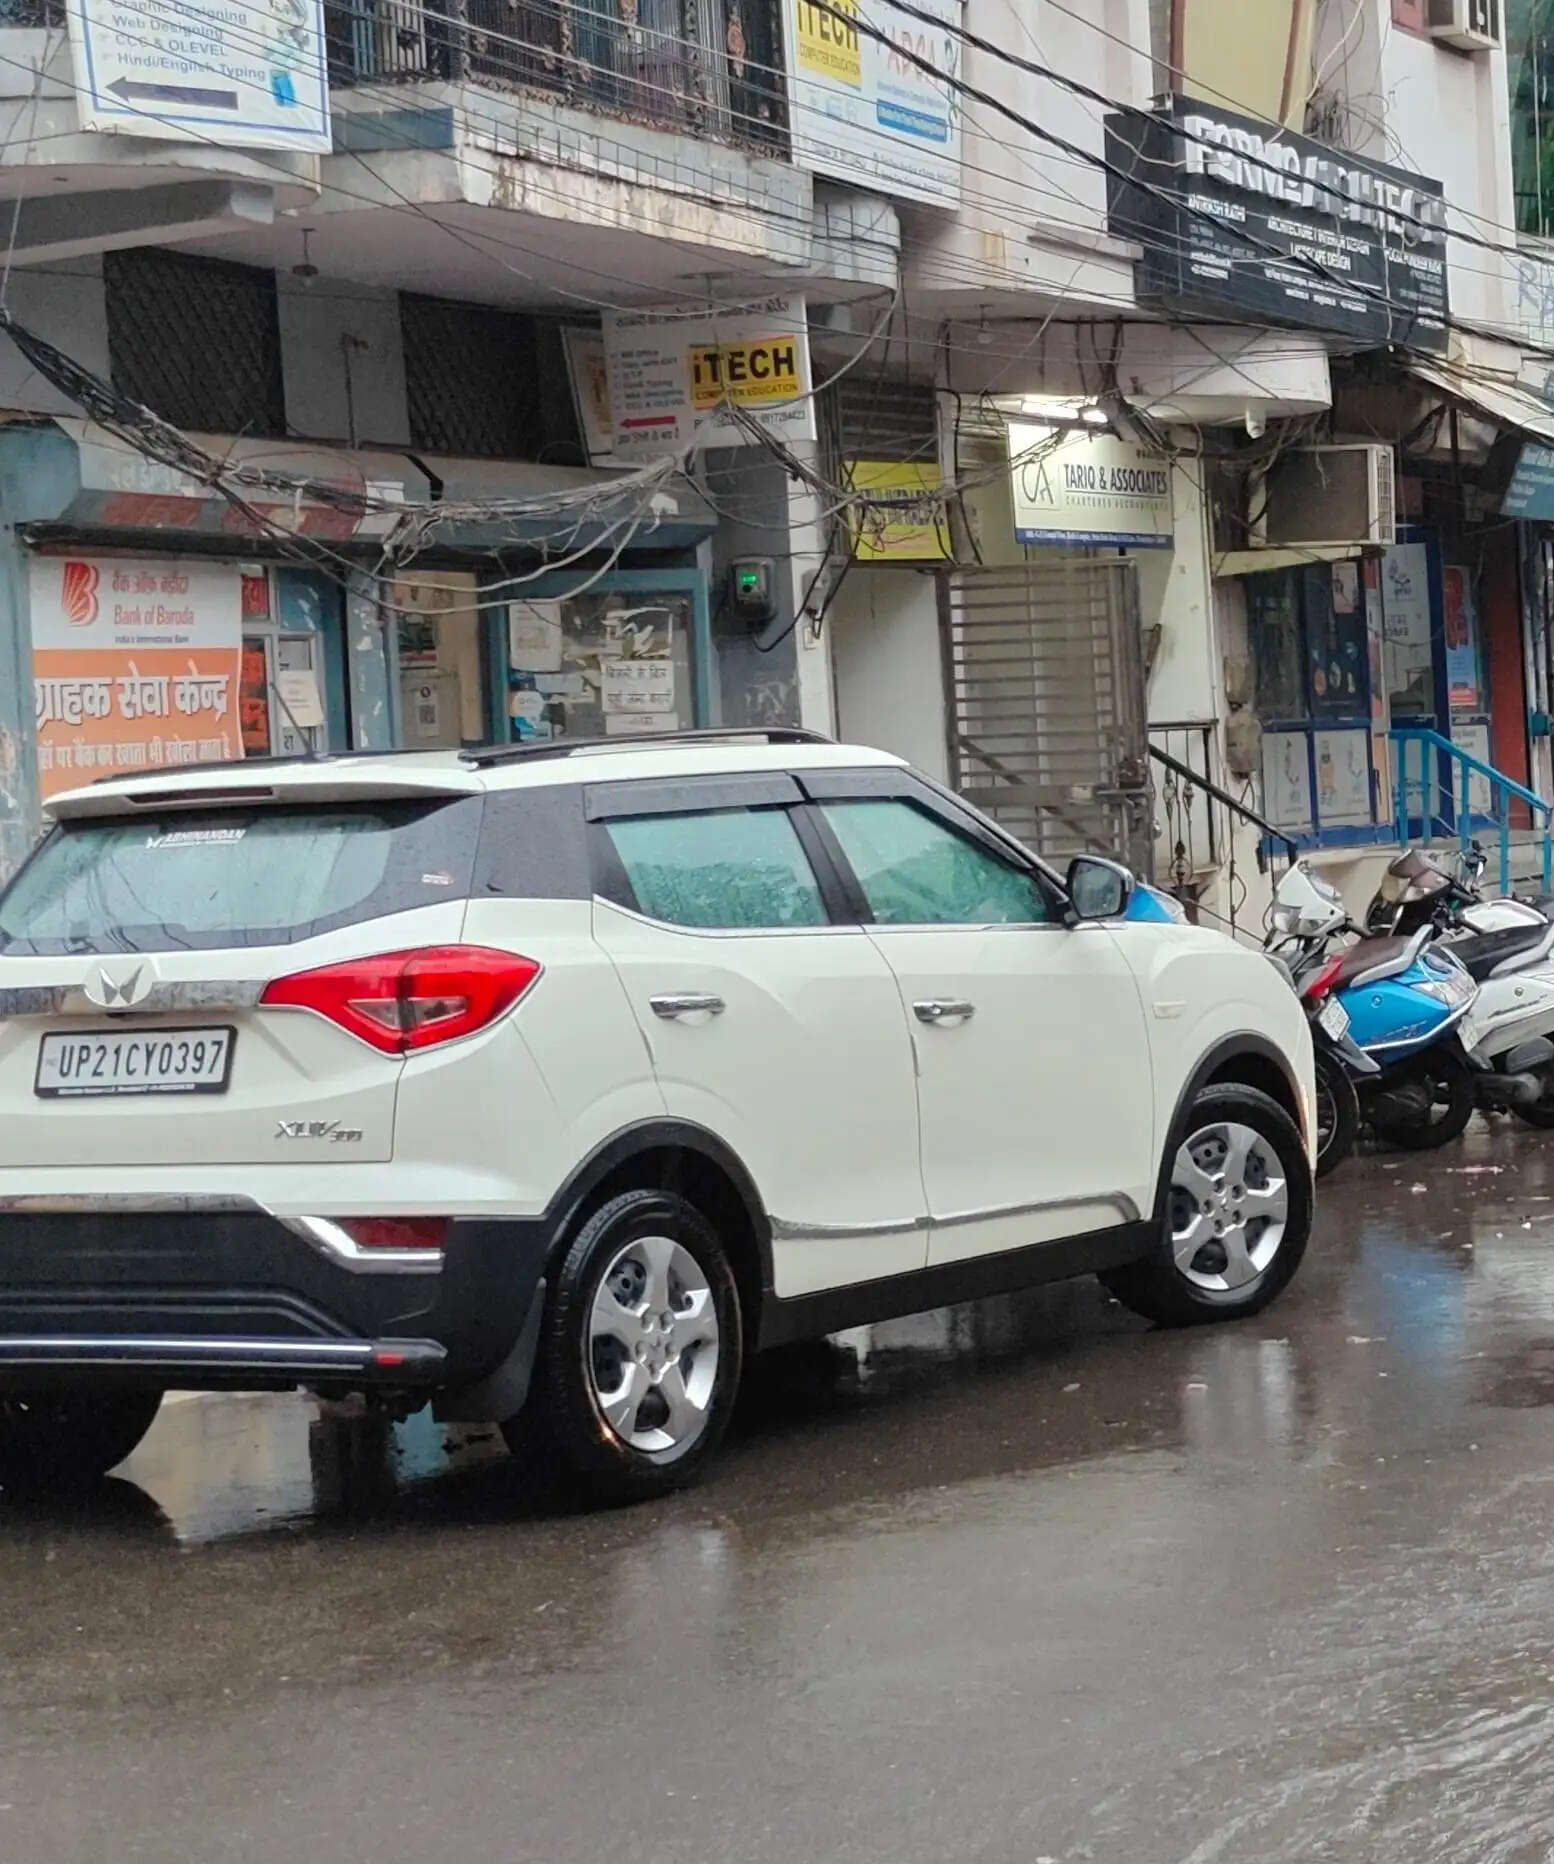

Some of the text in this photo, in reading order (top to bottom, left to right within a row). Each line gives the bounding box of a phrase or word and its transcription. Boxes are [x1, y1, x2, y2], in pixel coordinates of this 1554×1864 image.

[112, 15, 224, 41] Web Designing
[220, 63, 266, 81] Typing
[1064, 464, 1168, 495] TARIQ & ASSOCIATES
[114, 604, 194, 626] Bank of Baroda
[114, 660, 170, 720] सेवा
[59, 1041, 223, 1079] UP21CY0397
